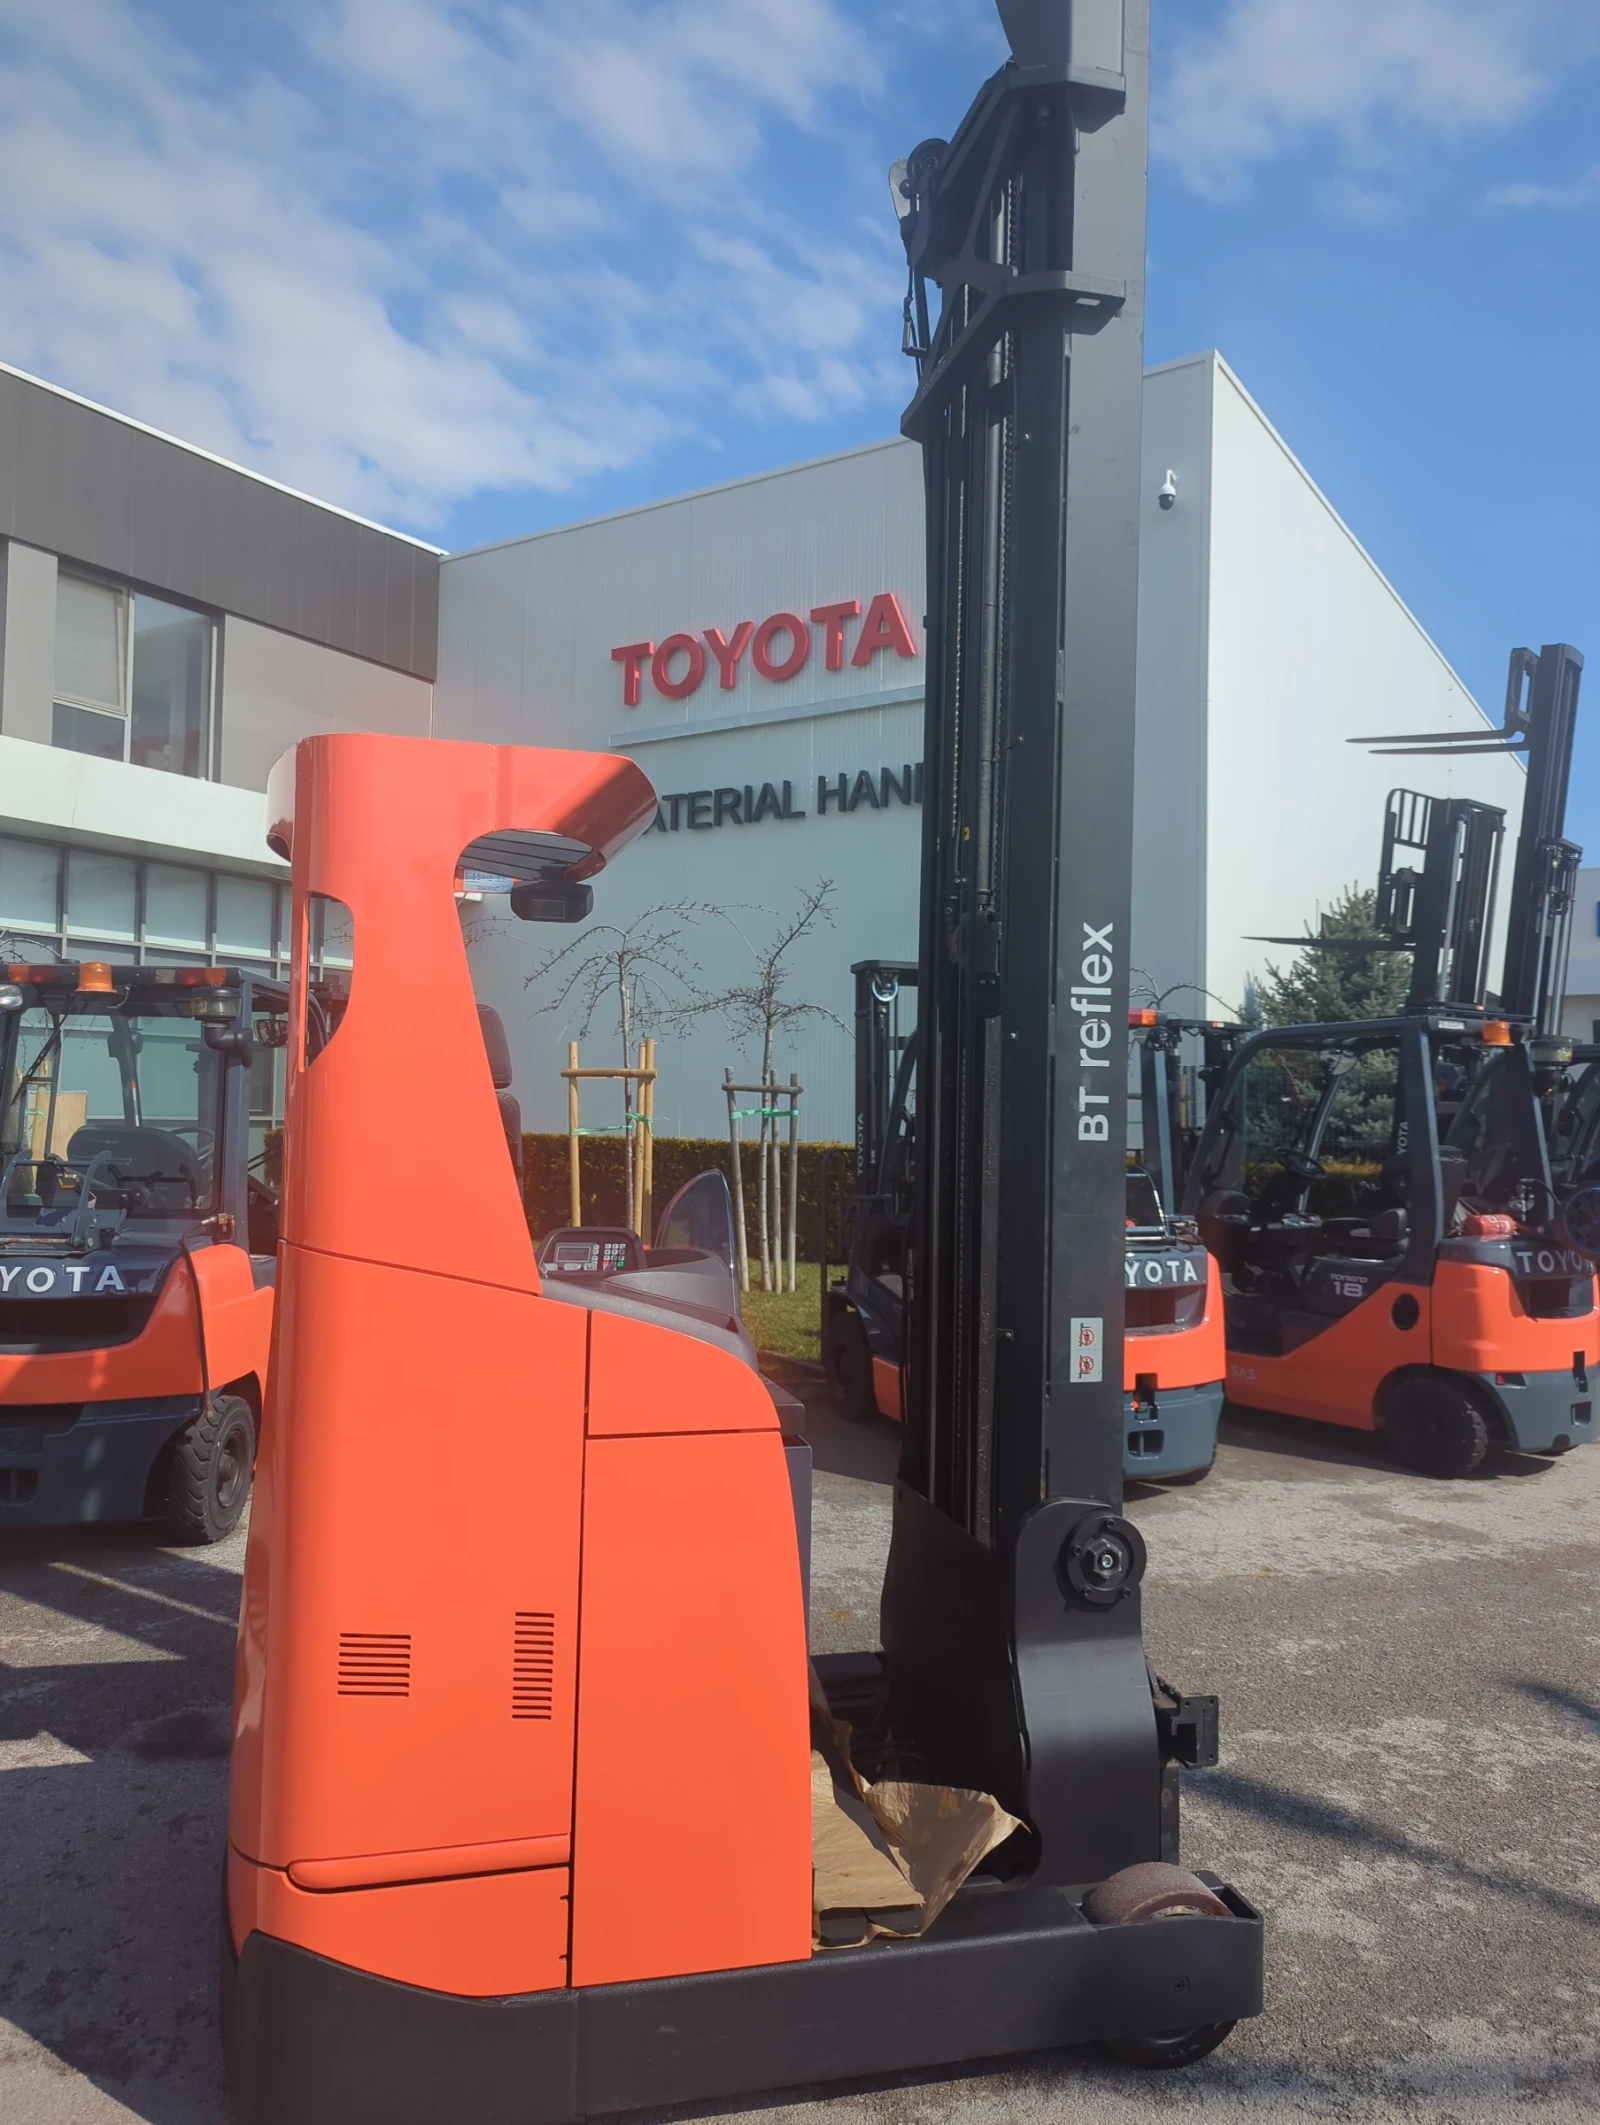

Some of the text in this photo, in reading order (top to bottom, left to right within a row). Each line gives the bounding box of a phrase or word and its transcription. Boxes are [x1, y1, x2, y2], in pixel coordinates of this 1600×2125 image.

[611, 592, 917, 707] TOYOTA
[1071, 922, 1114, 1142] BT reflex
[0, 1265, 125, 1292] YOTA
[1333, 1281, 1362, 1297] 18
[1231, 1365, 1256, 1380] SAS
